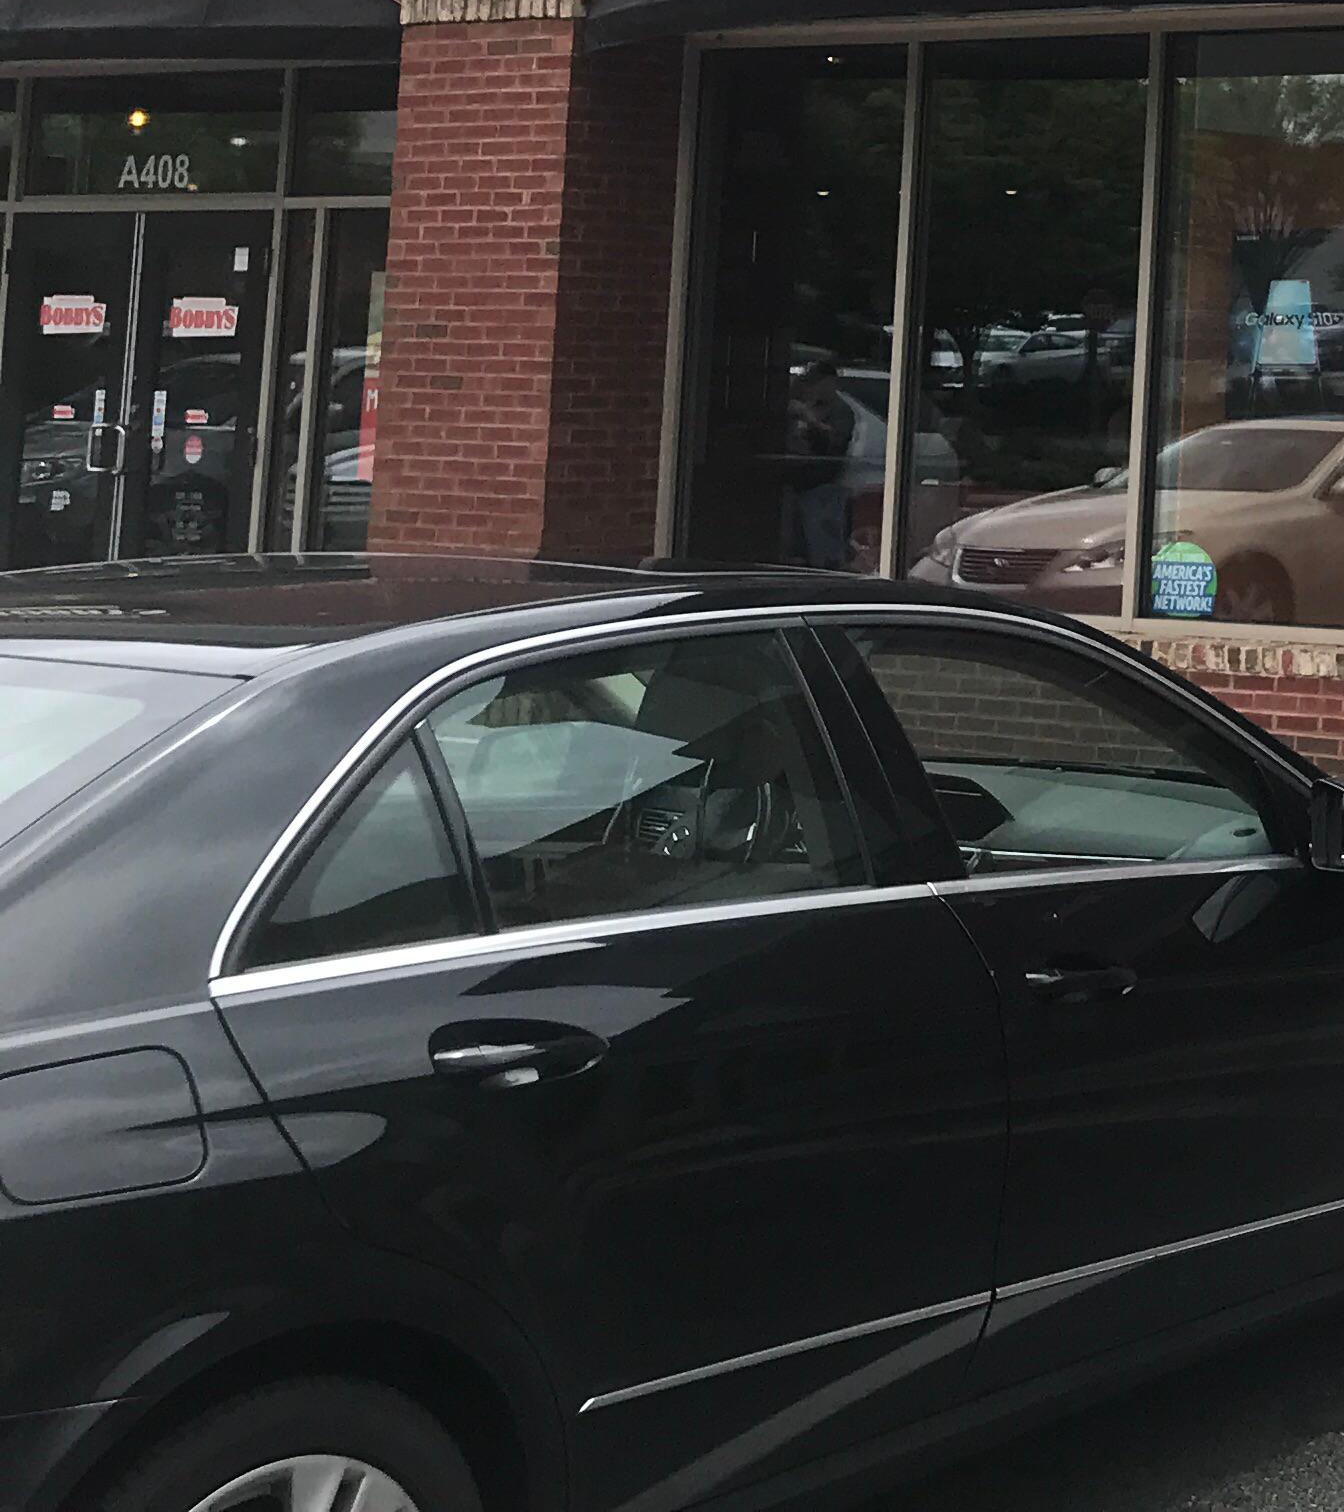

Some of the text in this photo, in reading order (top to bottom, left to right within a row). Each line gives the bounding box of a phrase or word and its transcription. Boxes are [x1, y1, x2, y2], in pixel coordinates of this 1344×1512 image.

[118, 154, 190, 188] A408
[1244, 312, 1305, 329] Galaxy
[1153, 564, 1213, 581] AMERICA'S
[1159, 580, 1207, 596] FASTEST
[1153, 595, 1213, 612] NETWORK!
